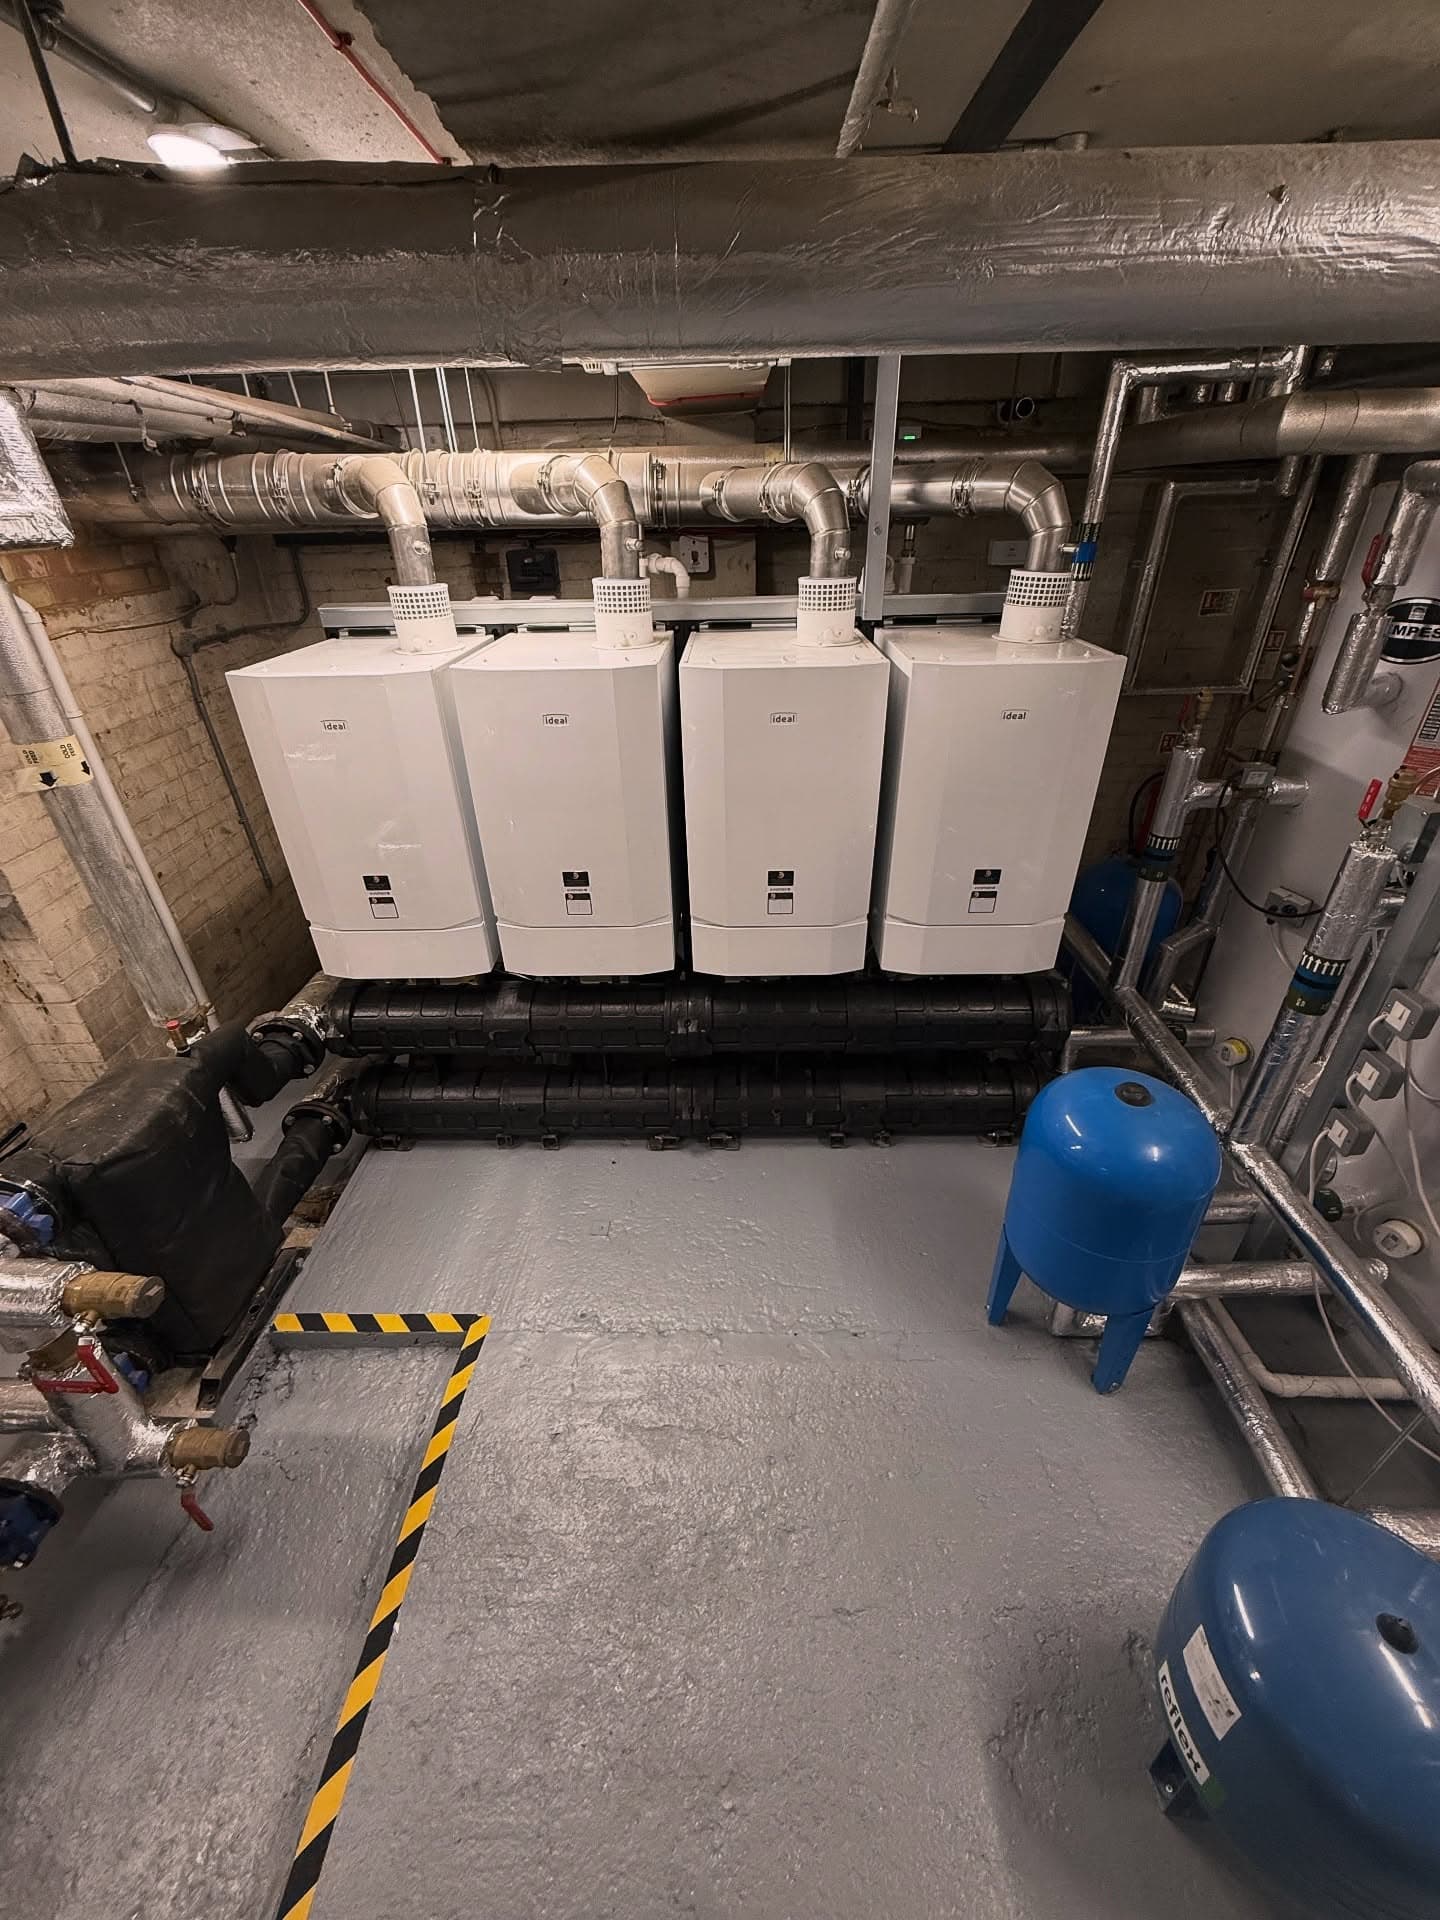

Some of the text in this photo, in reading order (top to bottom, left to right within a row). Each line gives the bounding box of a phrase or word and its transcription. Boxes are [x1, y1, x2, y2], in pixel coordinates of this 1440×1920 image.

[1391, 624, 1440, 639] MPES
[545, 716, 568, 725] ideal
[772, 714, 795, 724] ideal
[1002, 711, 1027, 720] ideal
[323, 720, 346, 731] ideal
[60, 744, 70, 759] COLD
[1160, 1674, 1201, 1773] reflex
